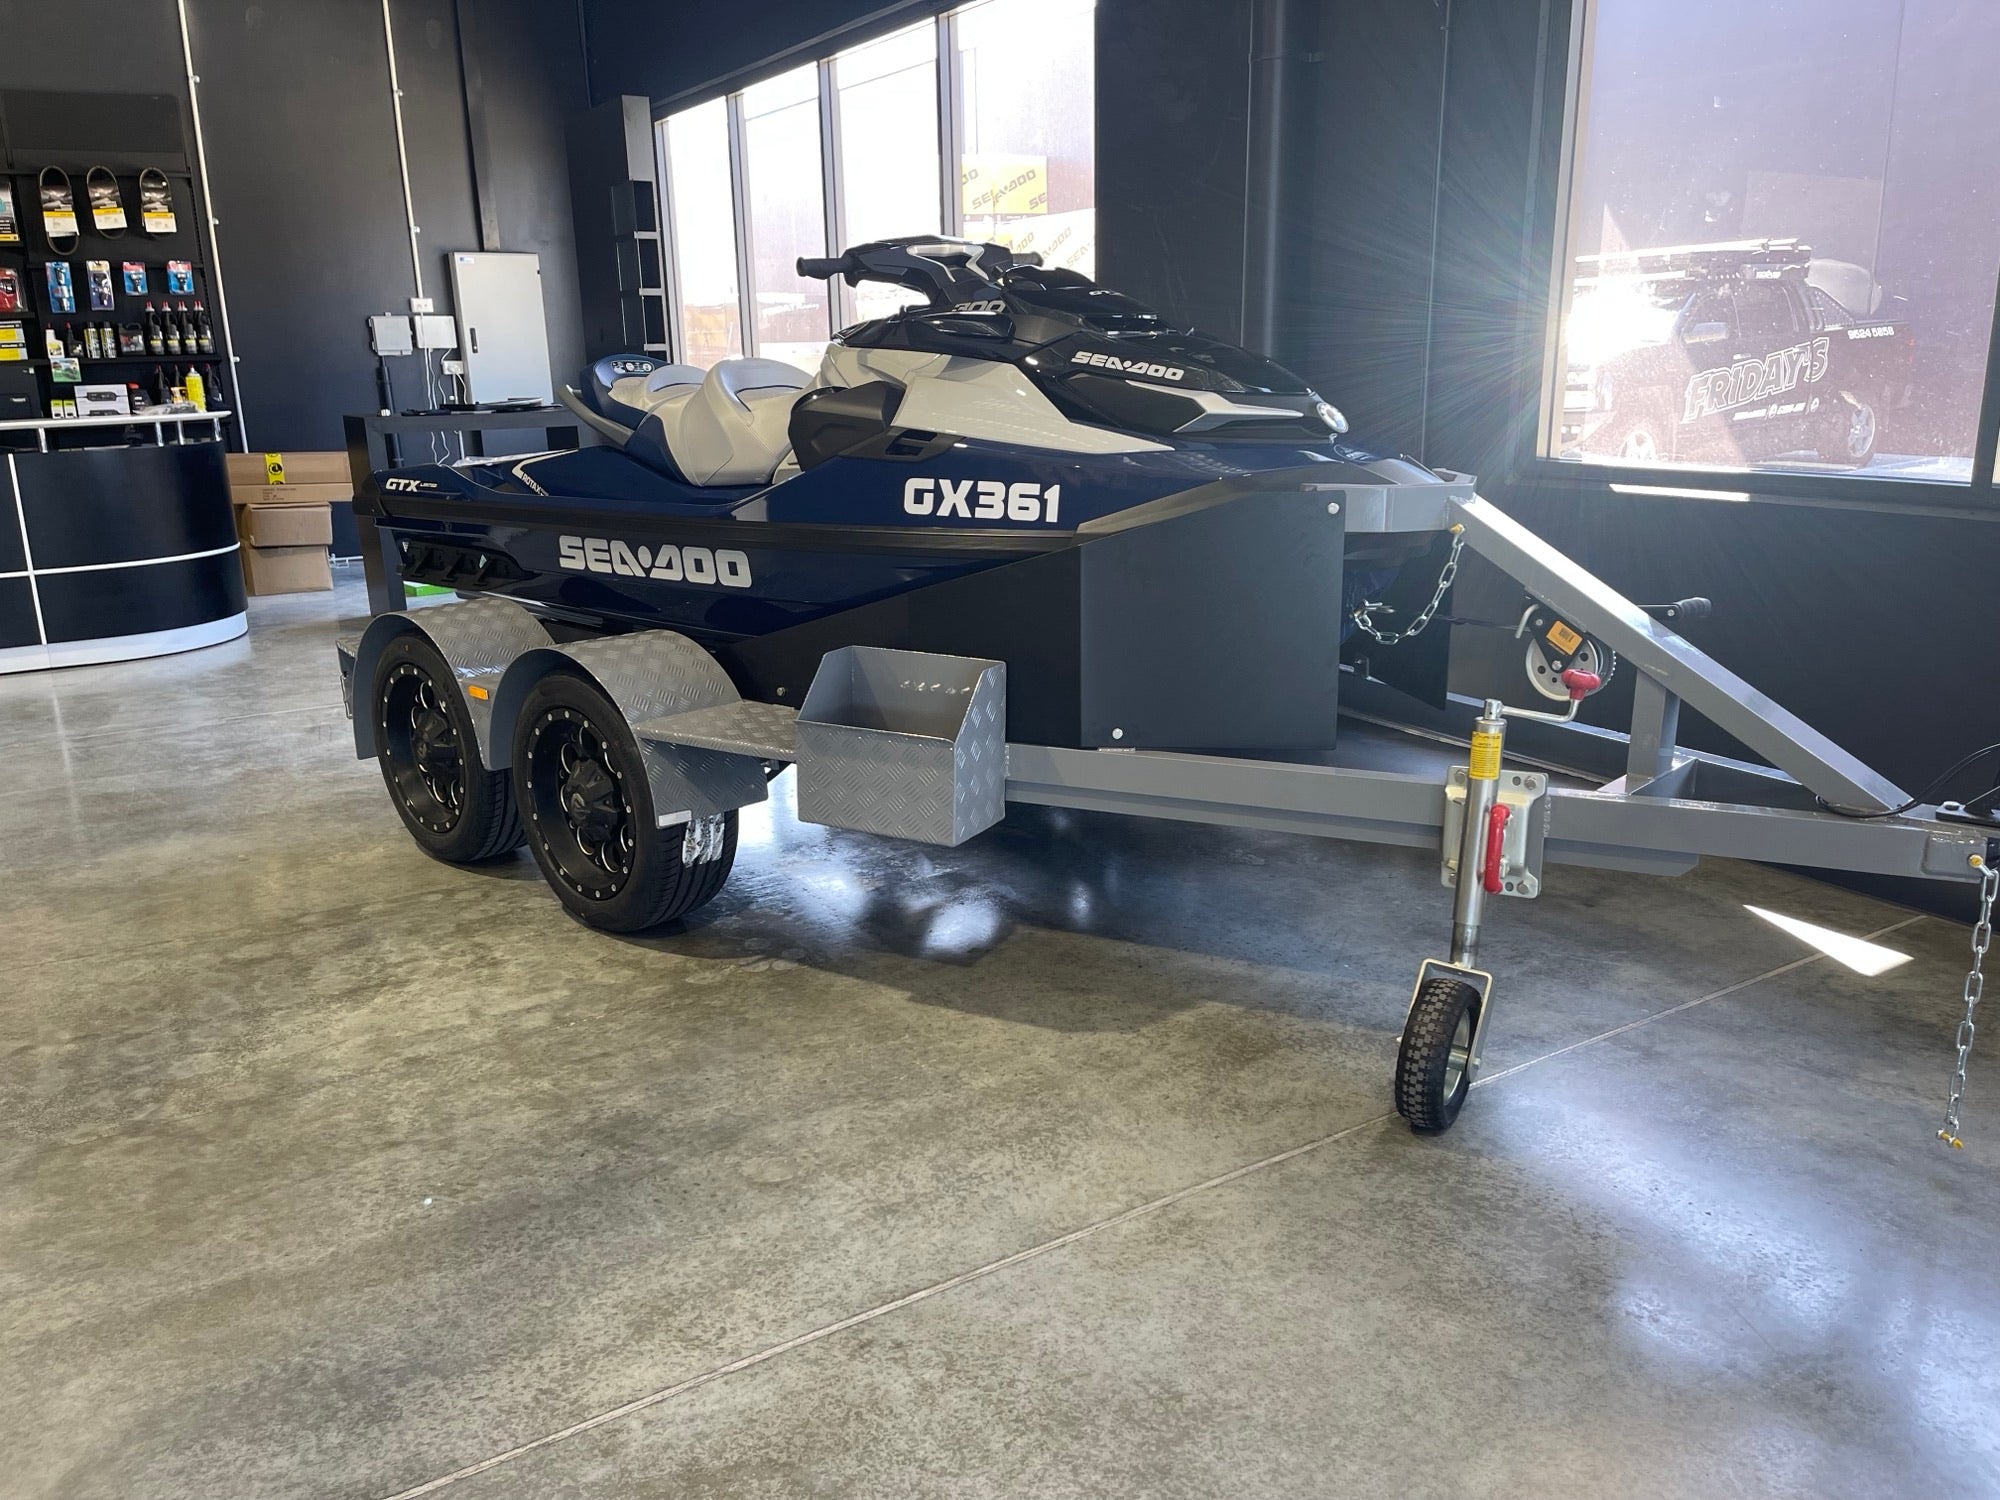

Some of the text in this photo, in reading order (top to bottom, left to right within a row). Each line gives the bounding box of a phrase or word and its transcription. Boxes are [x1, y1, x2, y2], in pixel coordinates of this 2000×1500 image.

[1680, 337, 1830, 424] FRIDAY'S
[385, 477, 421, 492] GTX
[903, 477, 1061, 523] GX361
